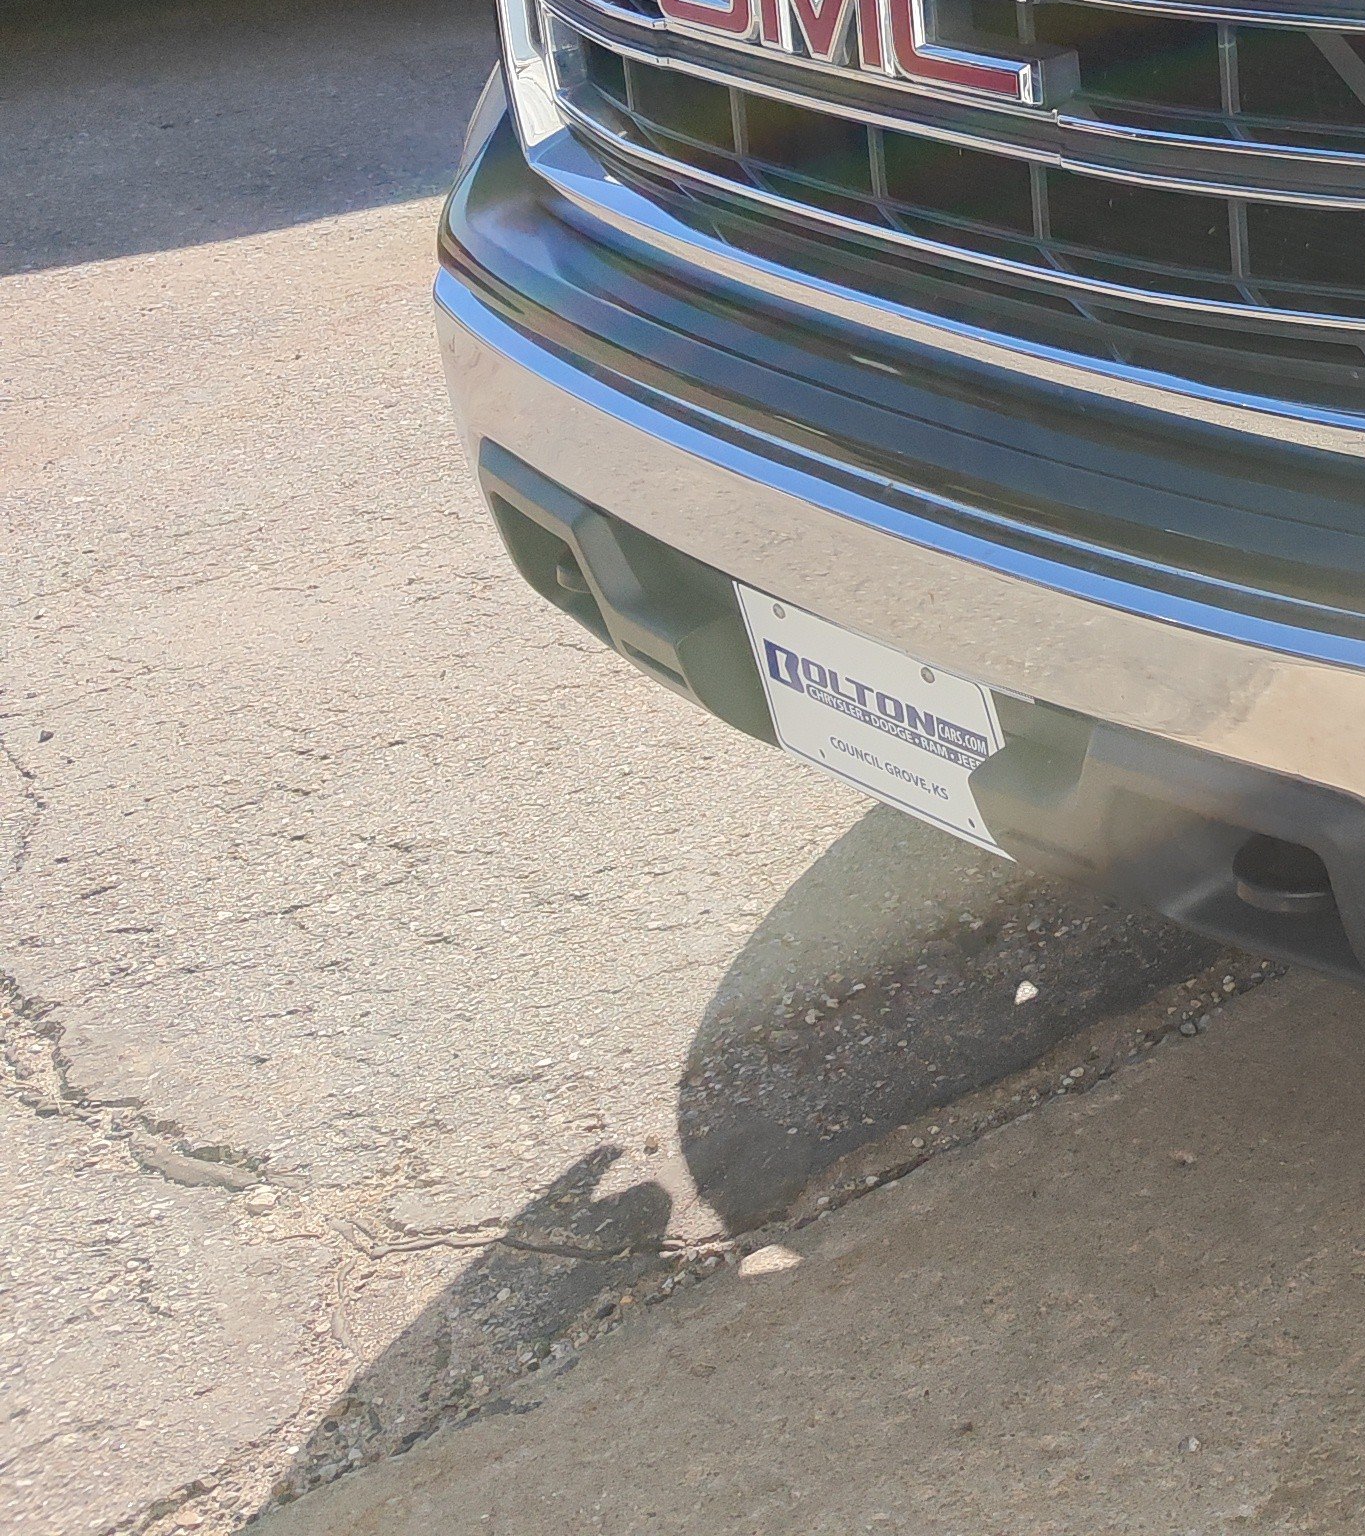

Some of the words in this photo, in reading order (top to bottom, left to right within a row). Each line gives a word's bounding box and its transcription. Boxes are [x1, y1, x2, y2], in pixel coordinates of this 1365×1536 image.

[763, 638, 936, 737] BOLTON
[938, 723, 988, 756] CARS.COM
[809, 686, 865, 722] CHRYSLER
[869, 714, 914, 744] DODGE
[919, 736, 949, 759] RAM
[829, 736, 884, 771] COUNCIL
[884, 762, 931, 794] GROVE,
[931, 782, 949, 801] KS
